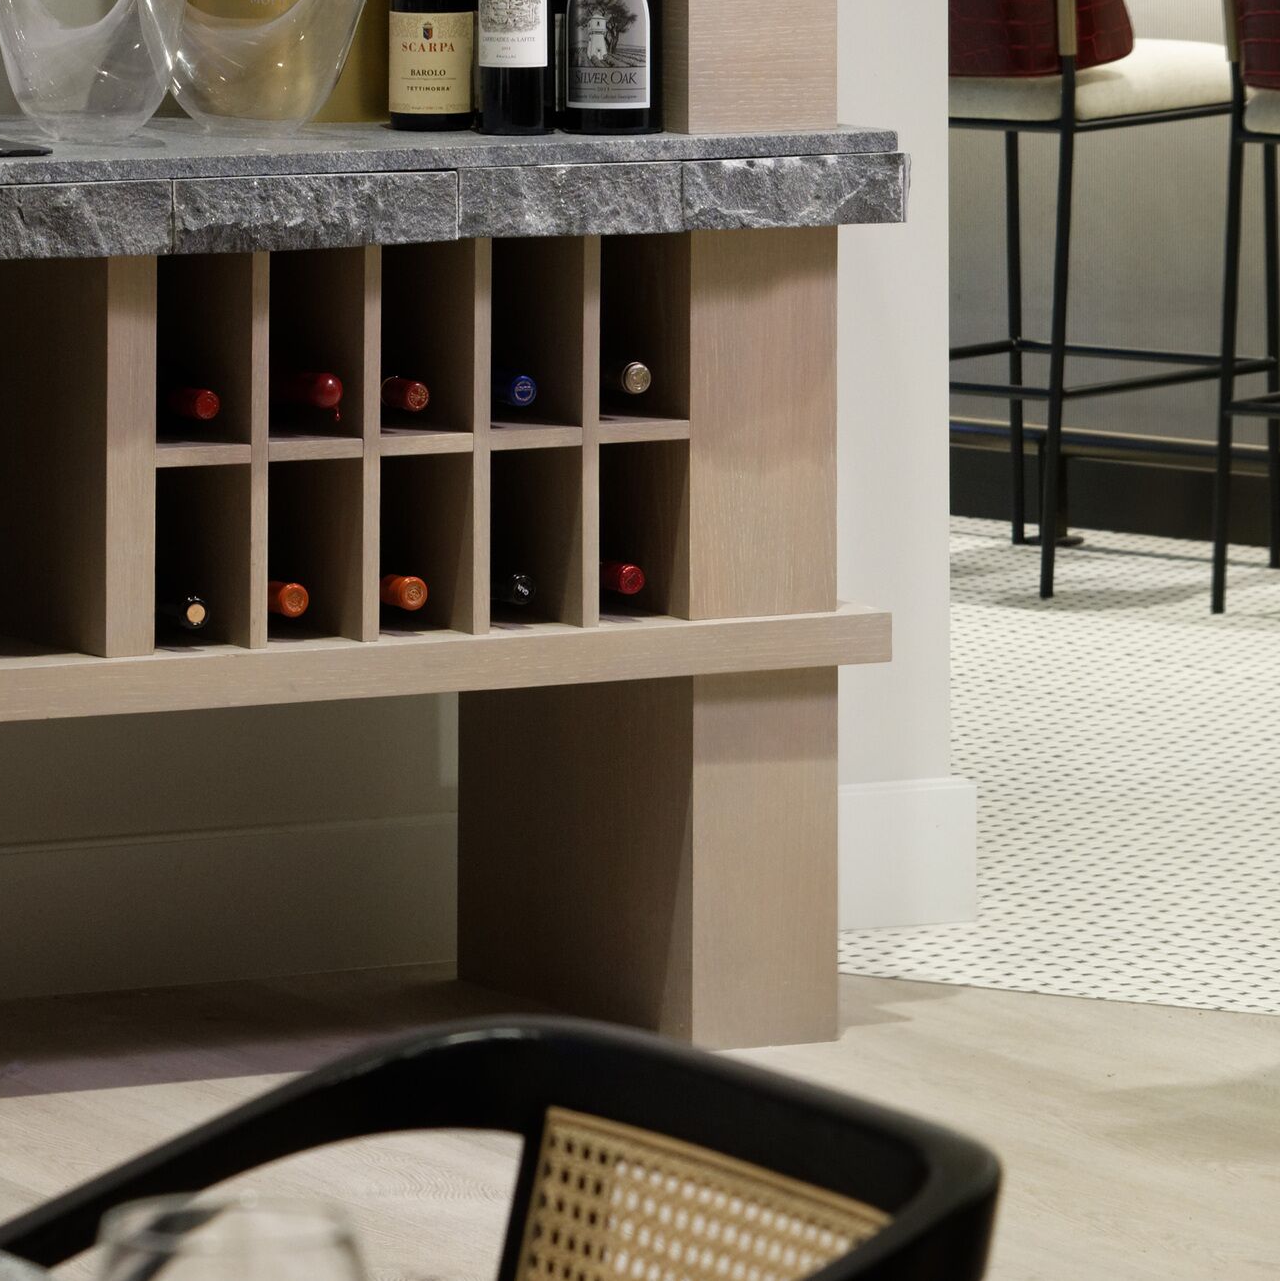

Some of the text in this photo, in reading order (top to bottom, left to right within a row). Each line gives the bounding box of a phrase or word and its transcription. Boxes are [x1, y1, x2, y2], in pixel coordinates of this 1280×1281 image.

[401, 41, 455, 53] SCARPA
[410, 68, 446, 77] BAROLO
[575, 70, 637, 85] SILVER OAK
